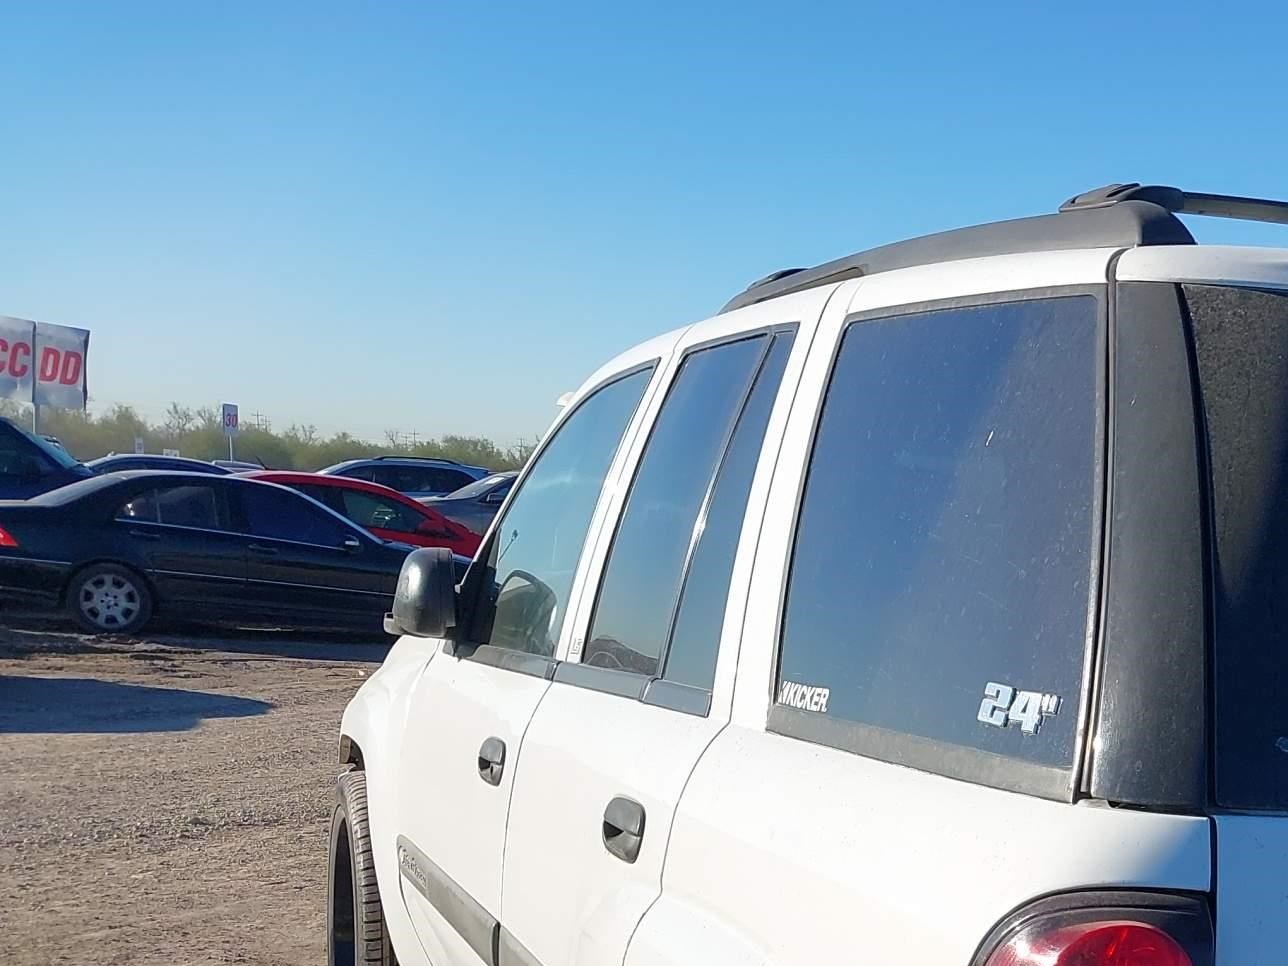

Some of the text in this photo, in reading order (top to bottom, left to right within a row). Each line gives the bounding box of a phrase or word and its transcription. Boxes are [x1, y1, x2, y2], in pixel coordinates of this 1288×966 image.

[39, 346, 82, 386] DD
[225, 413, 237, 428] 30
[977, 681, 1062, 735] 24"
